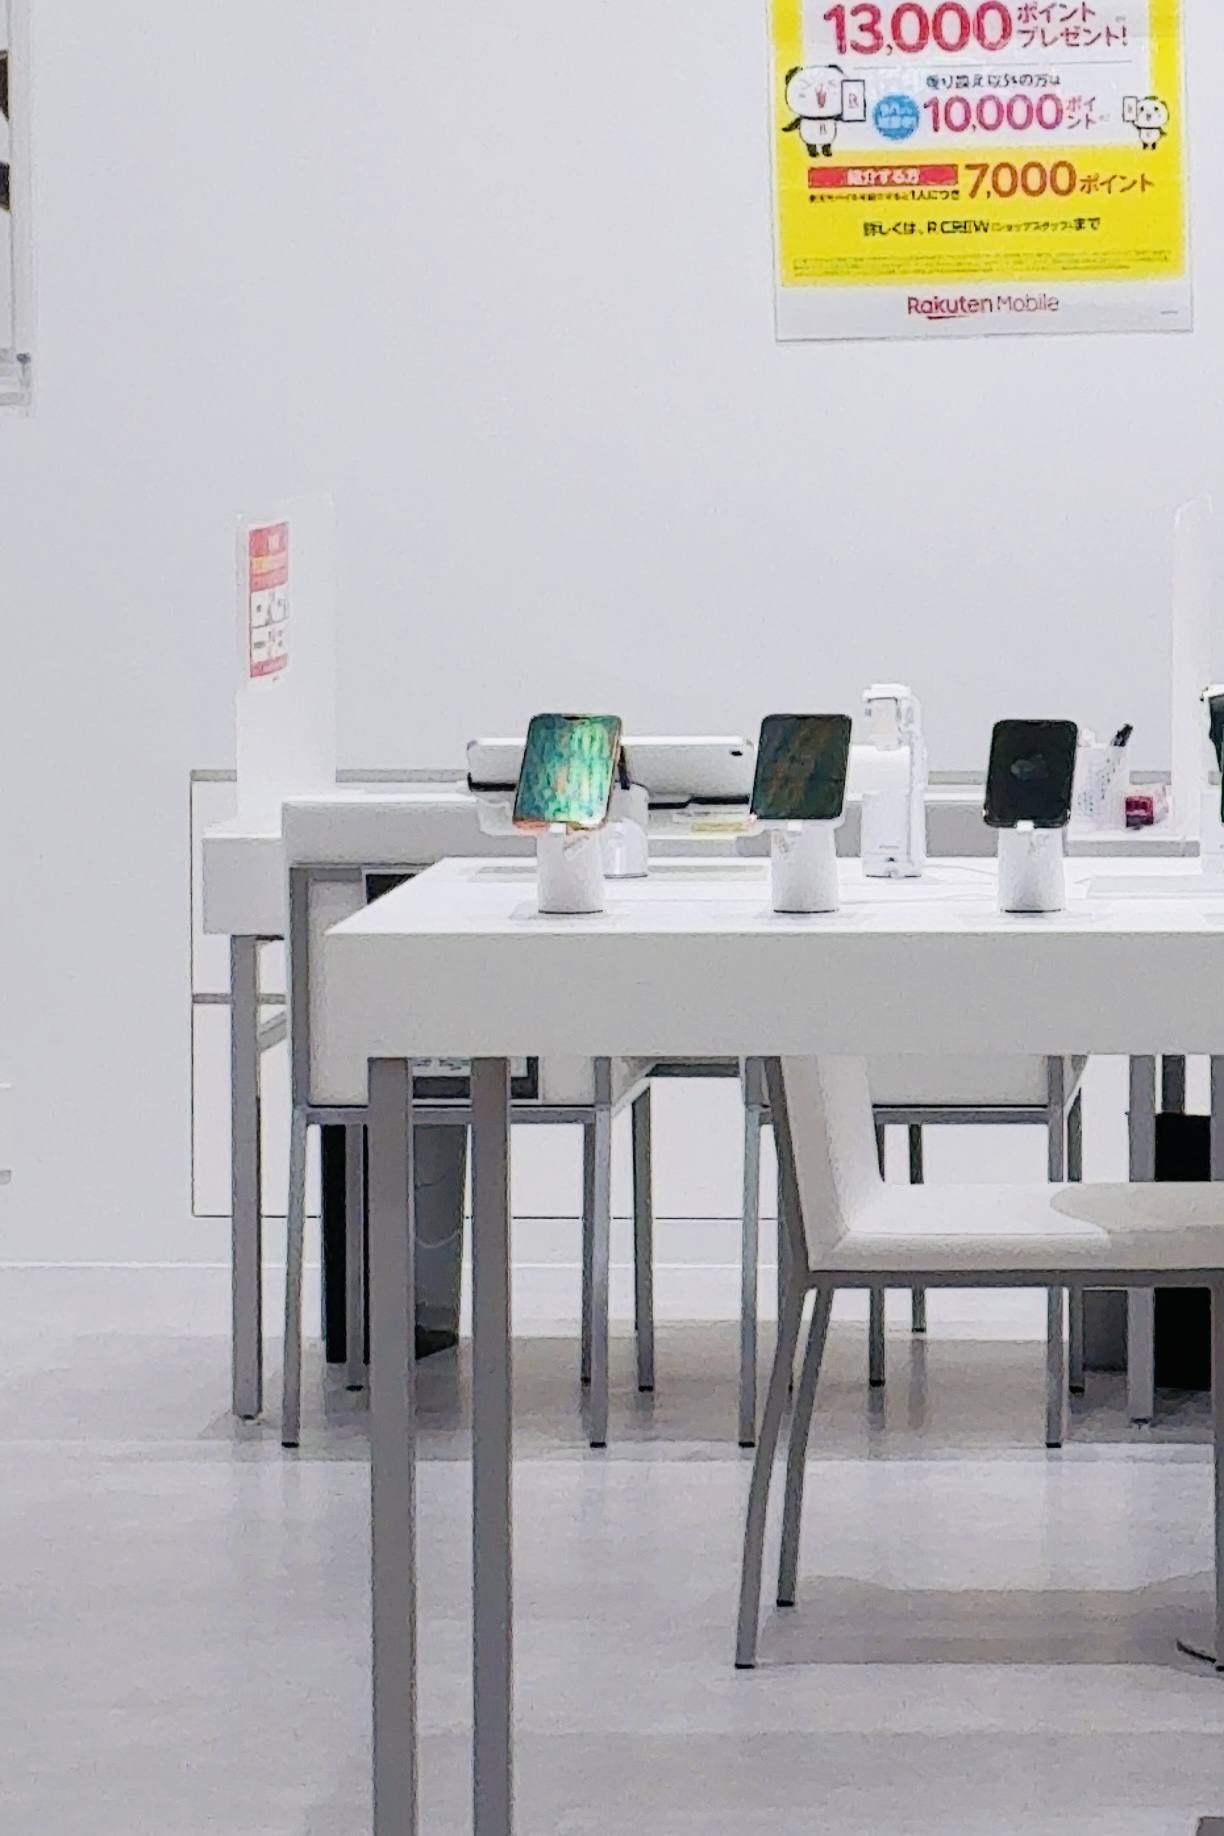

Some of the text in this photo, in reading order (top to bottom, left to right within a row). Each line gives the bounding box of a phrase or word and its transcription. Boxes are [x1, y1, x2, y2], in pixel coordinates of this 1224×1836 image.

[824, 2, 1095, 56] 13,000 ポイント
[923, 93, 1064, 133] 10,000
[965, 161, 1153, 199] 7,000 ポイント
[907, 293, 1059, 317] Rakuten Mobile
